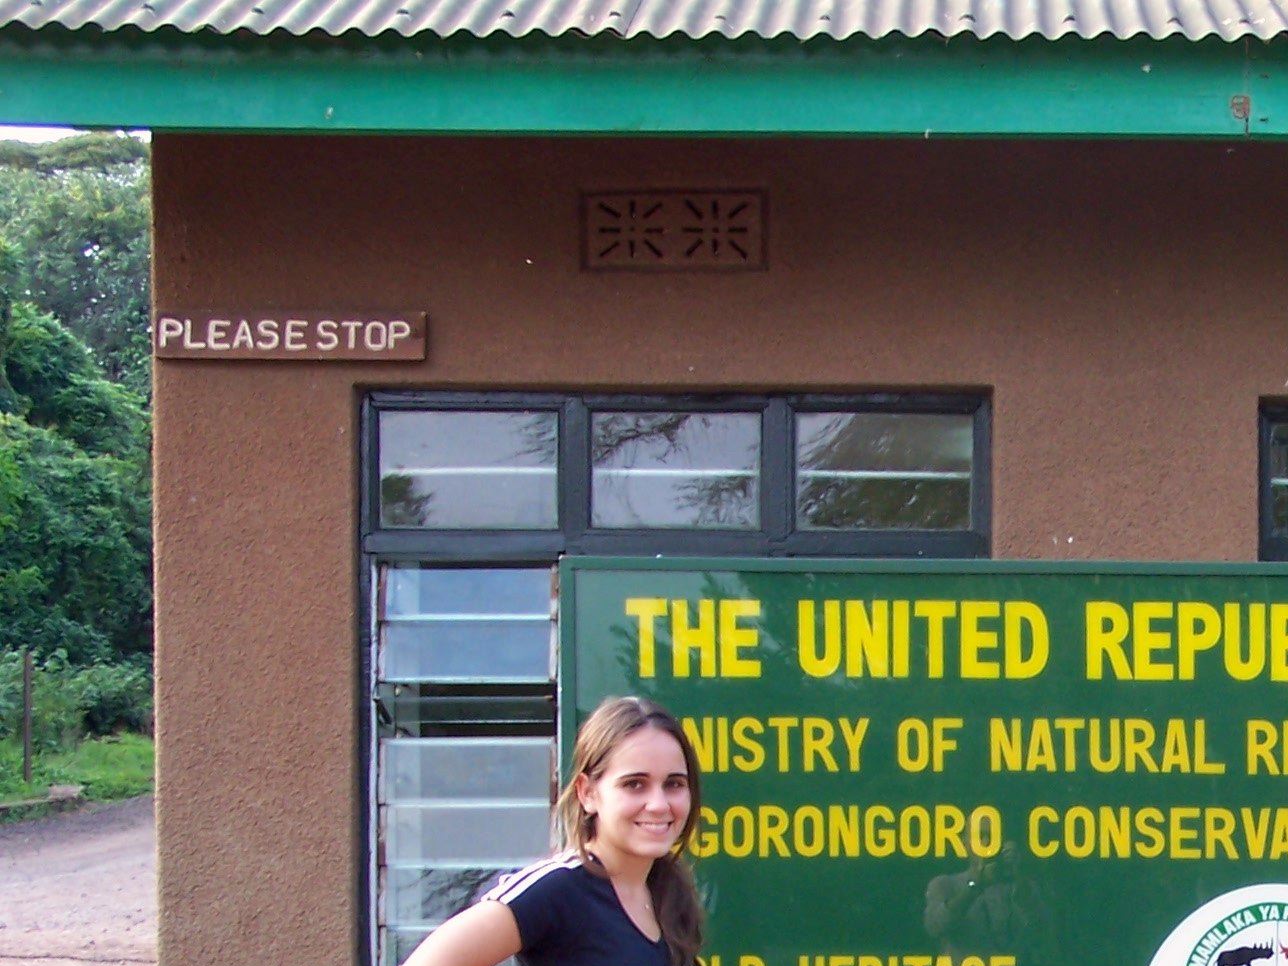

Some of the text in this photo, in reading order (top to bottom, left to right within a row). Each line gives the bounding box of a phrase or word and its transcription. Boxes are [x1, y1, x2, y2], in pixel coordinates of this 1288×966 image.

[158, 318, 410, 350] PLEASE STOP
[626, 598, 762, 678] THE
[798, 599, 1050, 680] UNITED
[682, 717, 869, 773] NISTRY
[897, 718, 964, 773] OF
[989, 718, 1226, 775] NATURAL
[670, 805, 1002, 858] GORONGORO
[1259, 904, 1280, 921] YA
